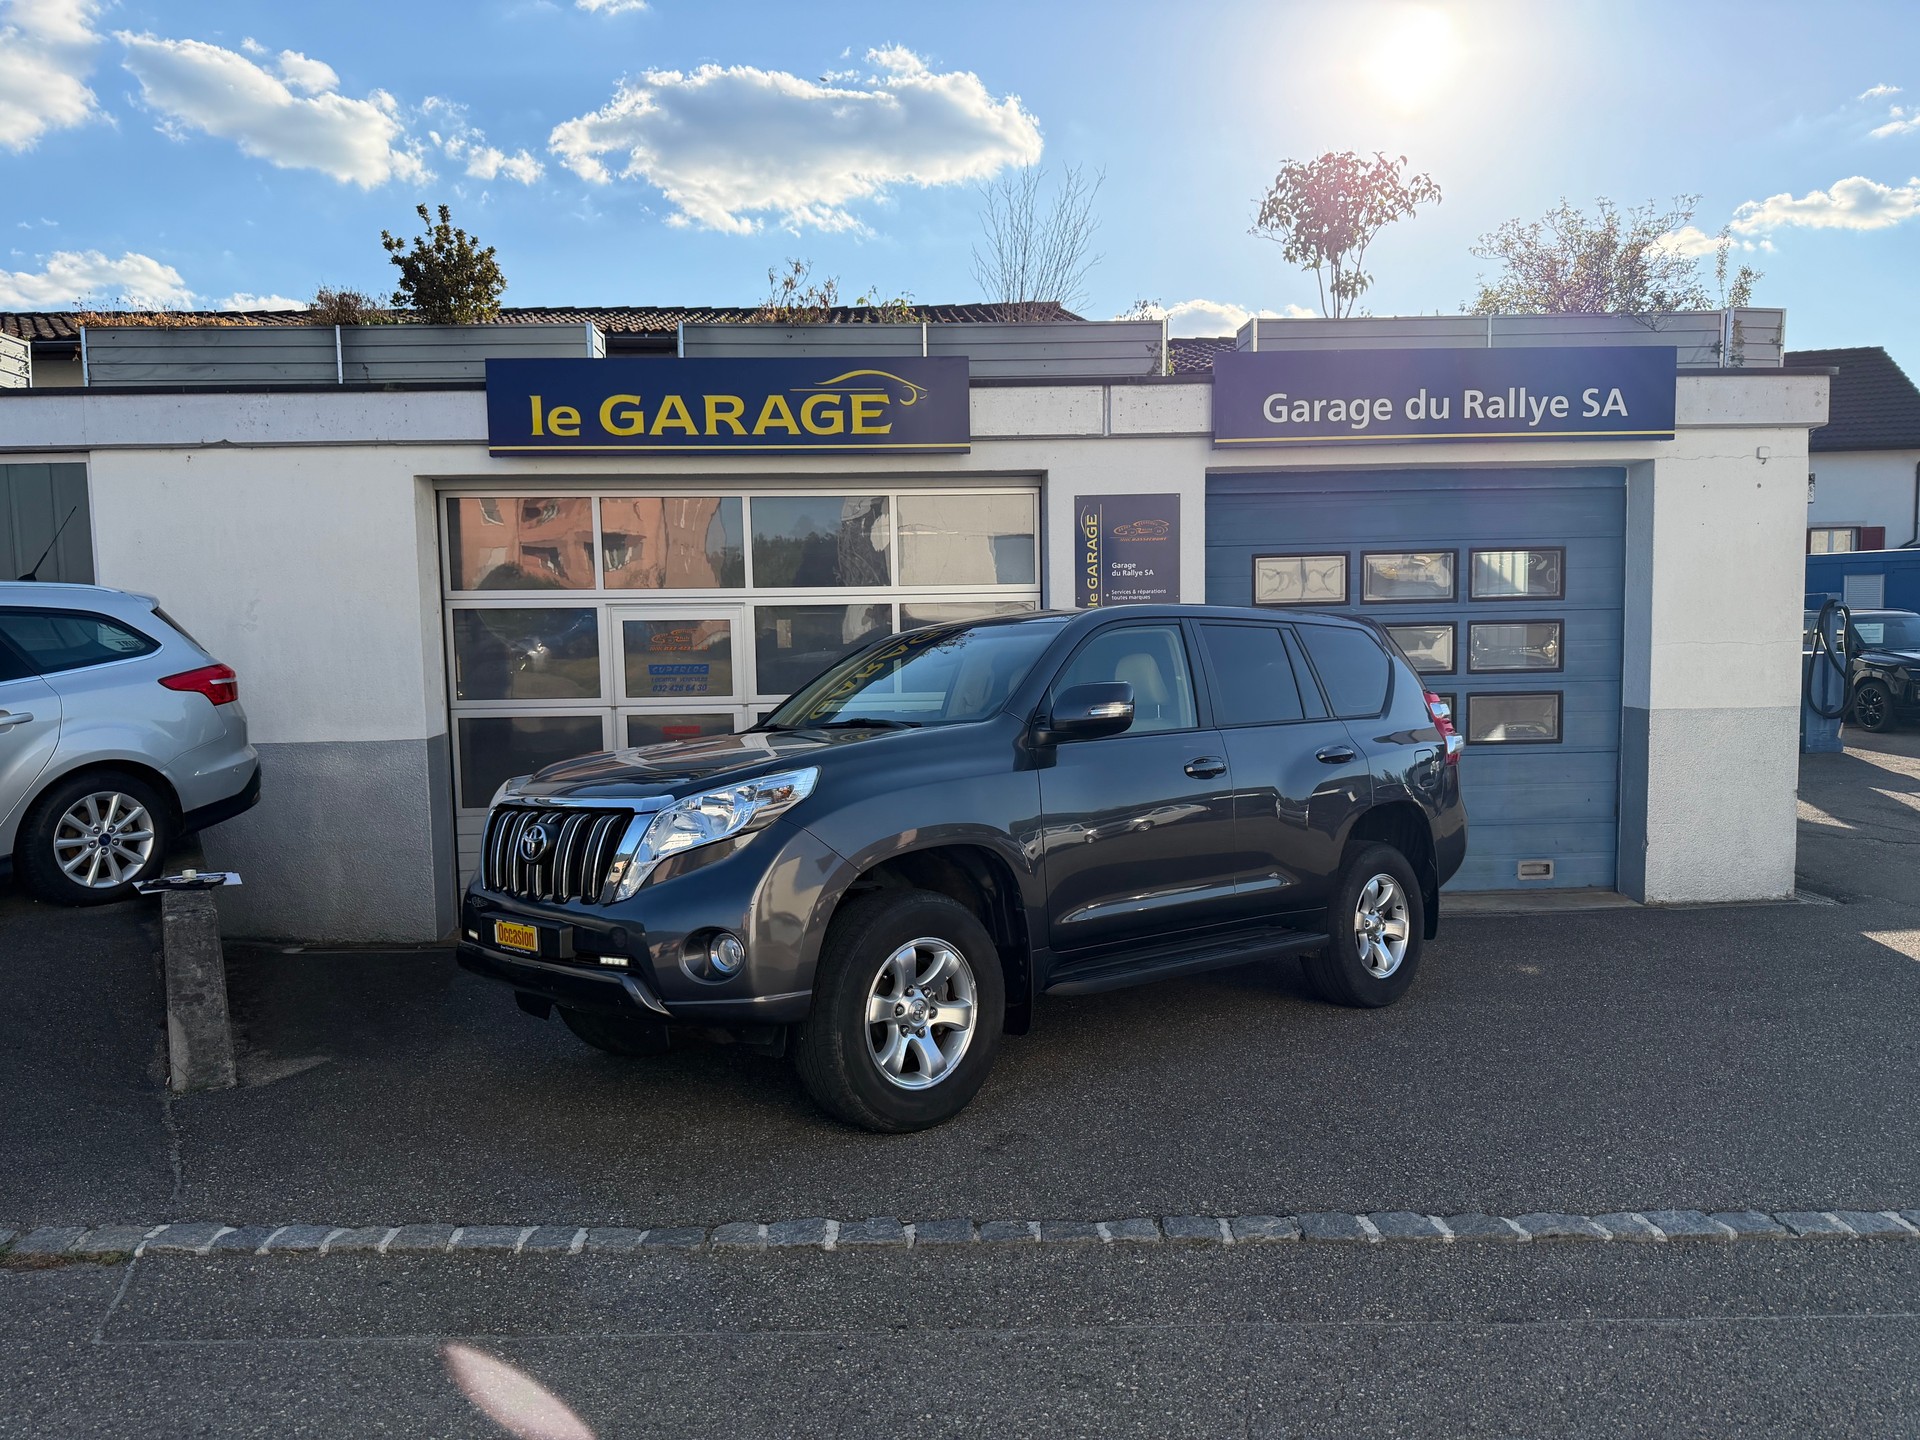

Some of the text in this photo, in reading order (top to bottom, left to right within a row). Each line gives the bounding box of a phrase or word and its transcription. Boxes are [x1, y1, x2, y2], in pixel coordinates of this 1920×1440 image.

[529, 393, 893, 437] le GARAGE
[1262, 387, 1629, 430] Garage du Rallye SA
[1087, 514, 1099, 608] le GARAGE
[1111, 562, 1137, 570] Garage
[1111, 569, 1121, 577] du
[1122, 569, 1143, 578] Rallye
[498, 923, 534, 947] Occasion
